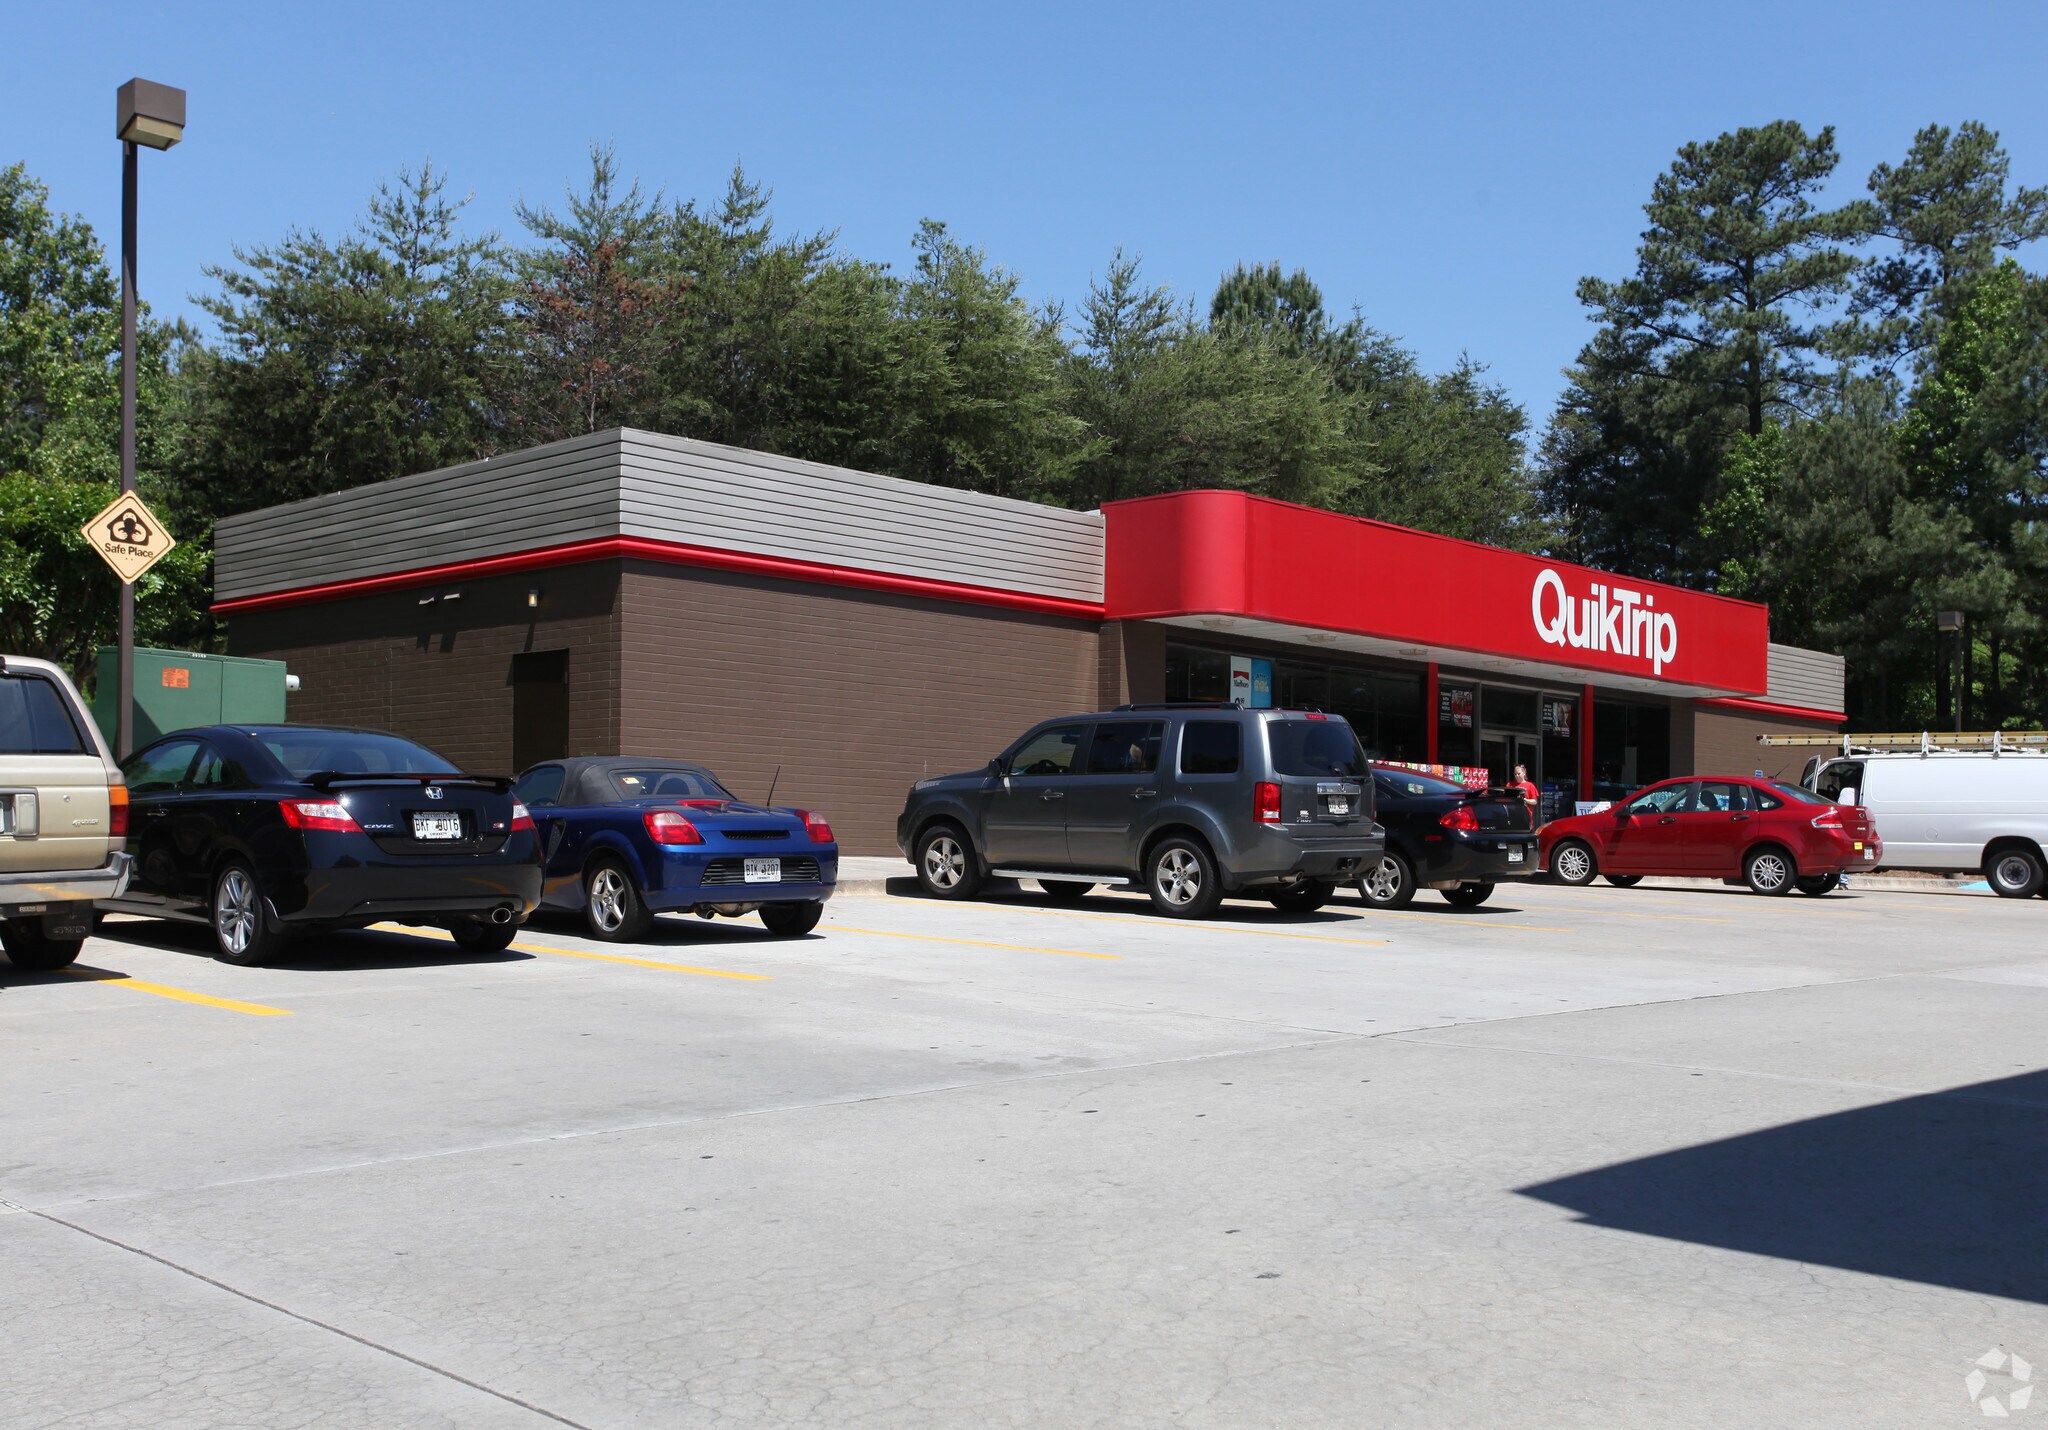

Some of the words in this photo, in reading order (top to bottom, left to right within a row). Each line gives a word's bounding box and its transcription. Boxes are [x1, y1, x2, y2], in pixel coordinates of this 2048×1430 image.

[104, 542, 126, 555] Safe
[128, 546, 154, 558] Place
[1531, 568, 1678, 676] QuikTrip
[415, 818, 430, 831] BKF
